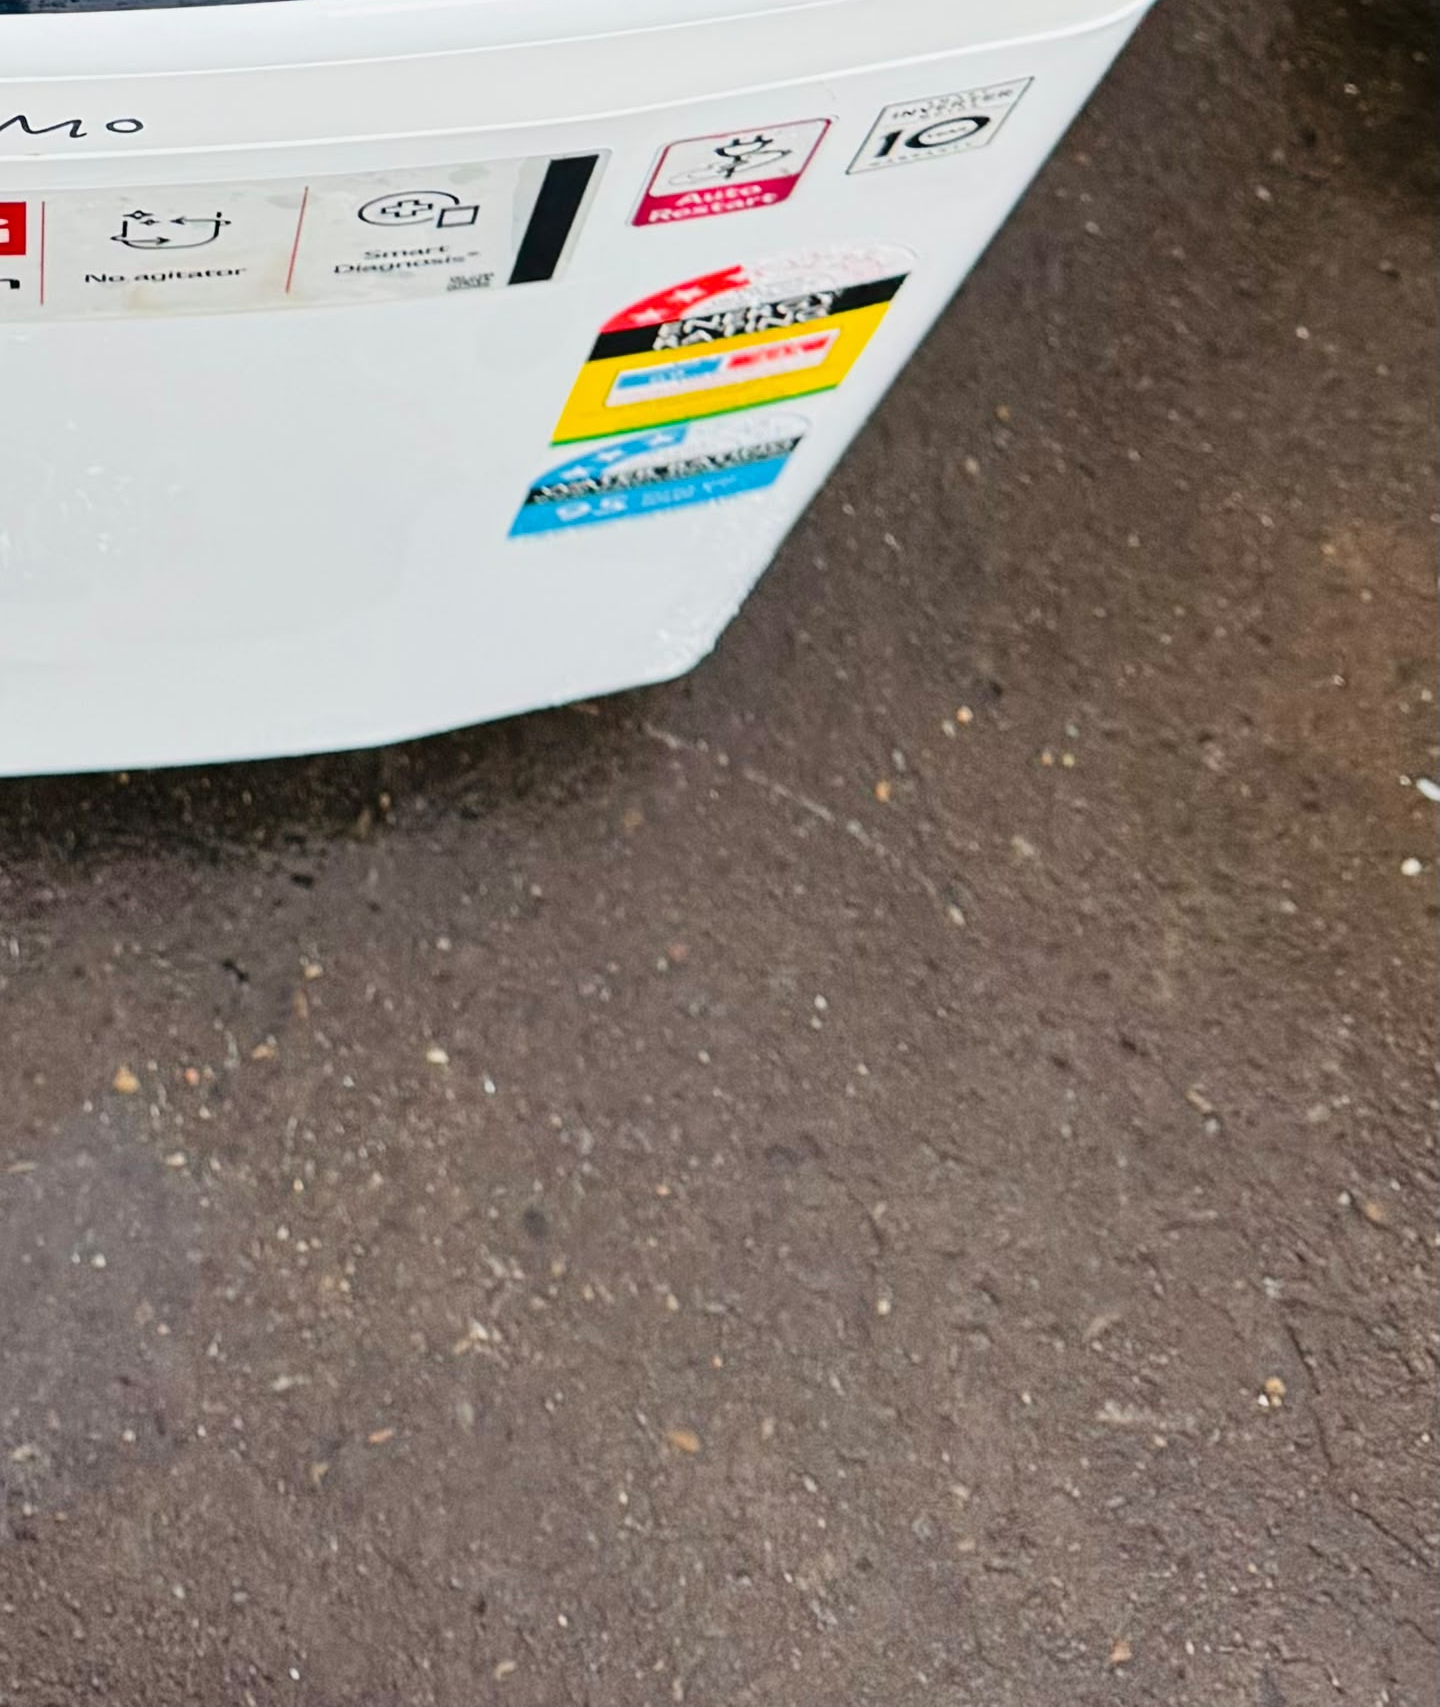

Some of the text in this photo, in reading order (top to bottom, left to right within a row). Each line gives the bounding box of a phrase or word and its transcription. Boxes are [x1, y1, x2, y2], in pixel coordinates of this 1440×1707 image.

[676, 184, 763, 207] Auto
[648, 192, 778, 223] Restart
[363, 243, 450, 260] Smart
[85, 266, 247, 284] No agitator
